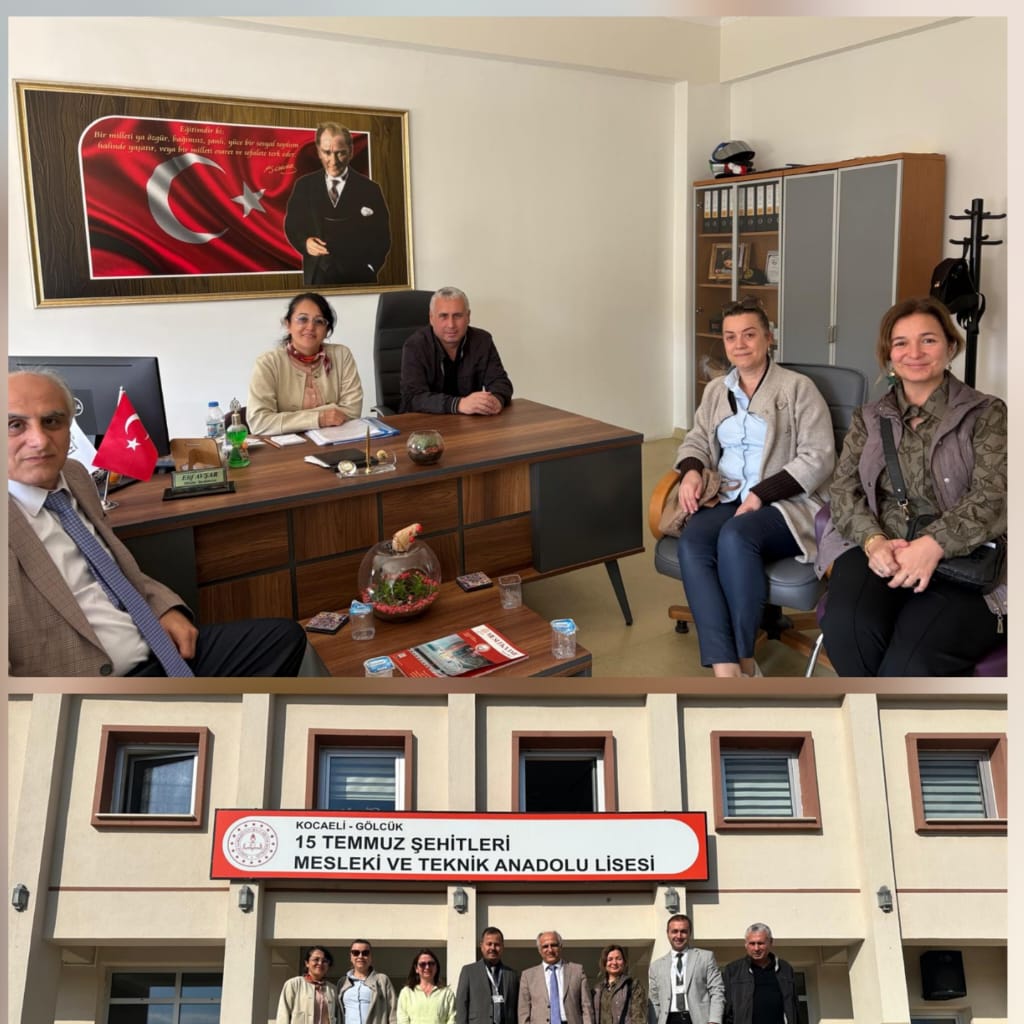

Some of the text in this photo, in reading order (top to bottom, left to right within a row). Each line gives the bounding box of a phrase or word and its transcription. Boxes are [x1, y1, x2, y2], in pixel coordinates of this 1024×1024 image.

[295, 820, 346, 830] KOCAELİ
[355, 820, 403, 831] GÖLCÜK
[295, 834, 510, 854] 15 TEMMUZ ŞEHİTLERİ
[294, 854, 655, 872] MESLEKİ VE TEKNİK ANADOLU LİSESİ
